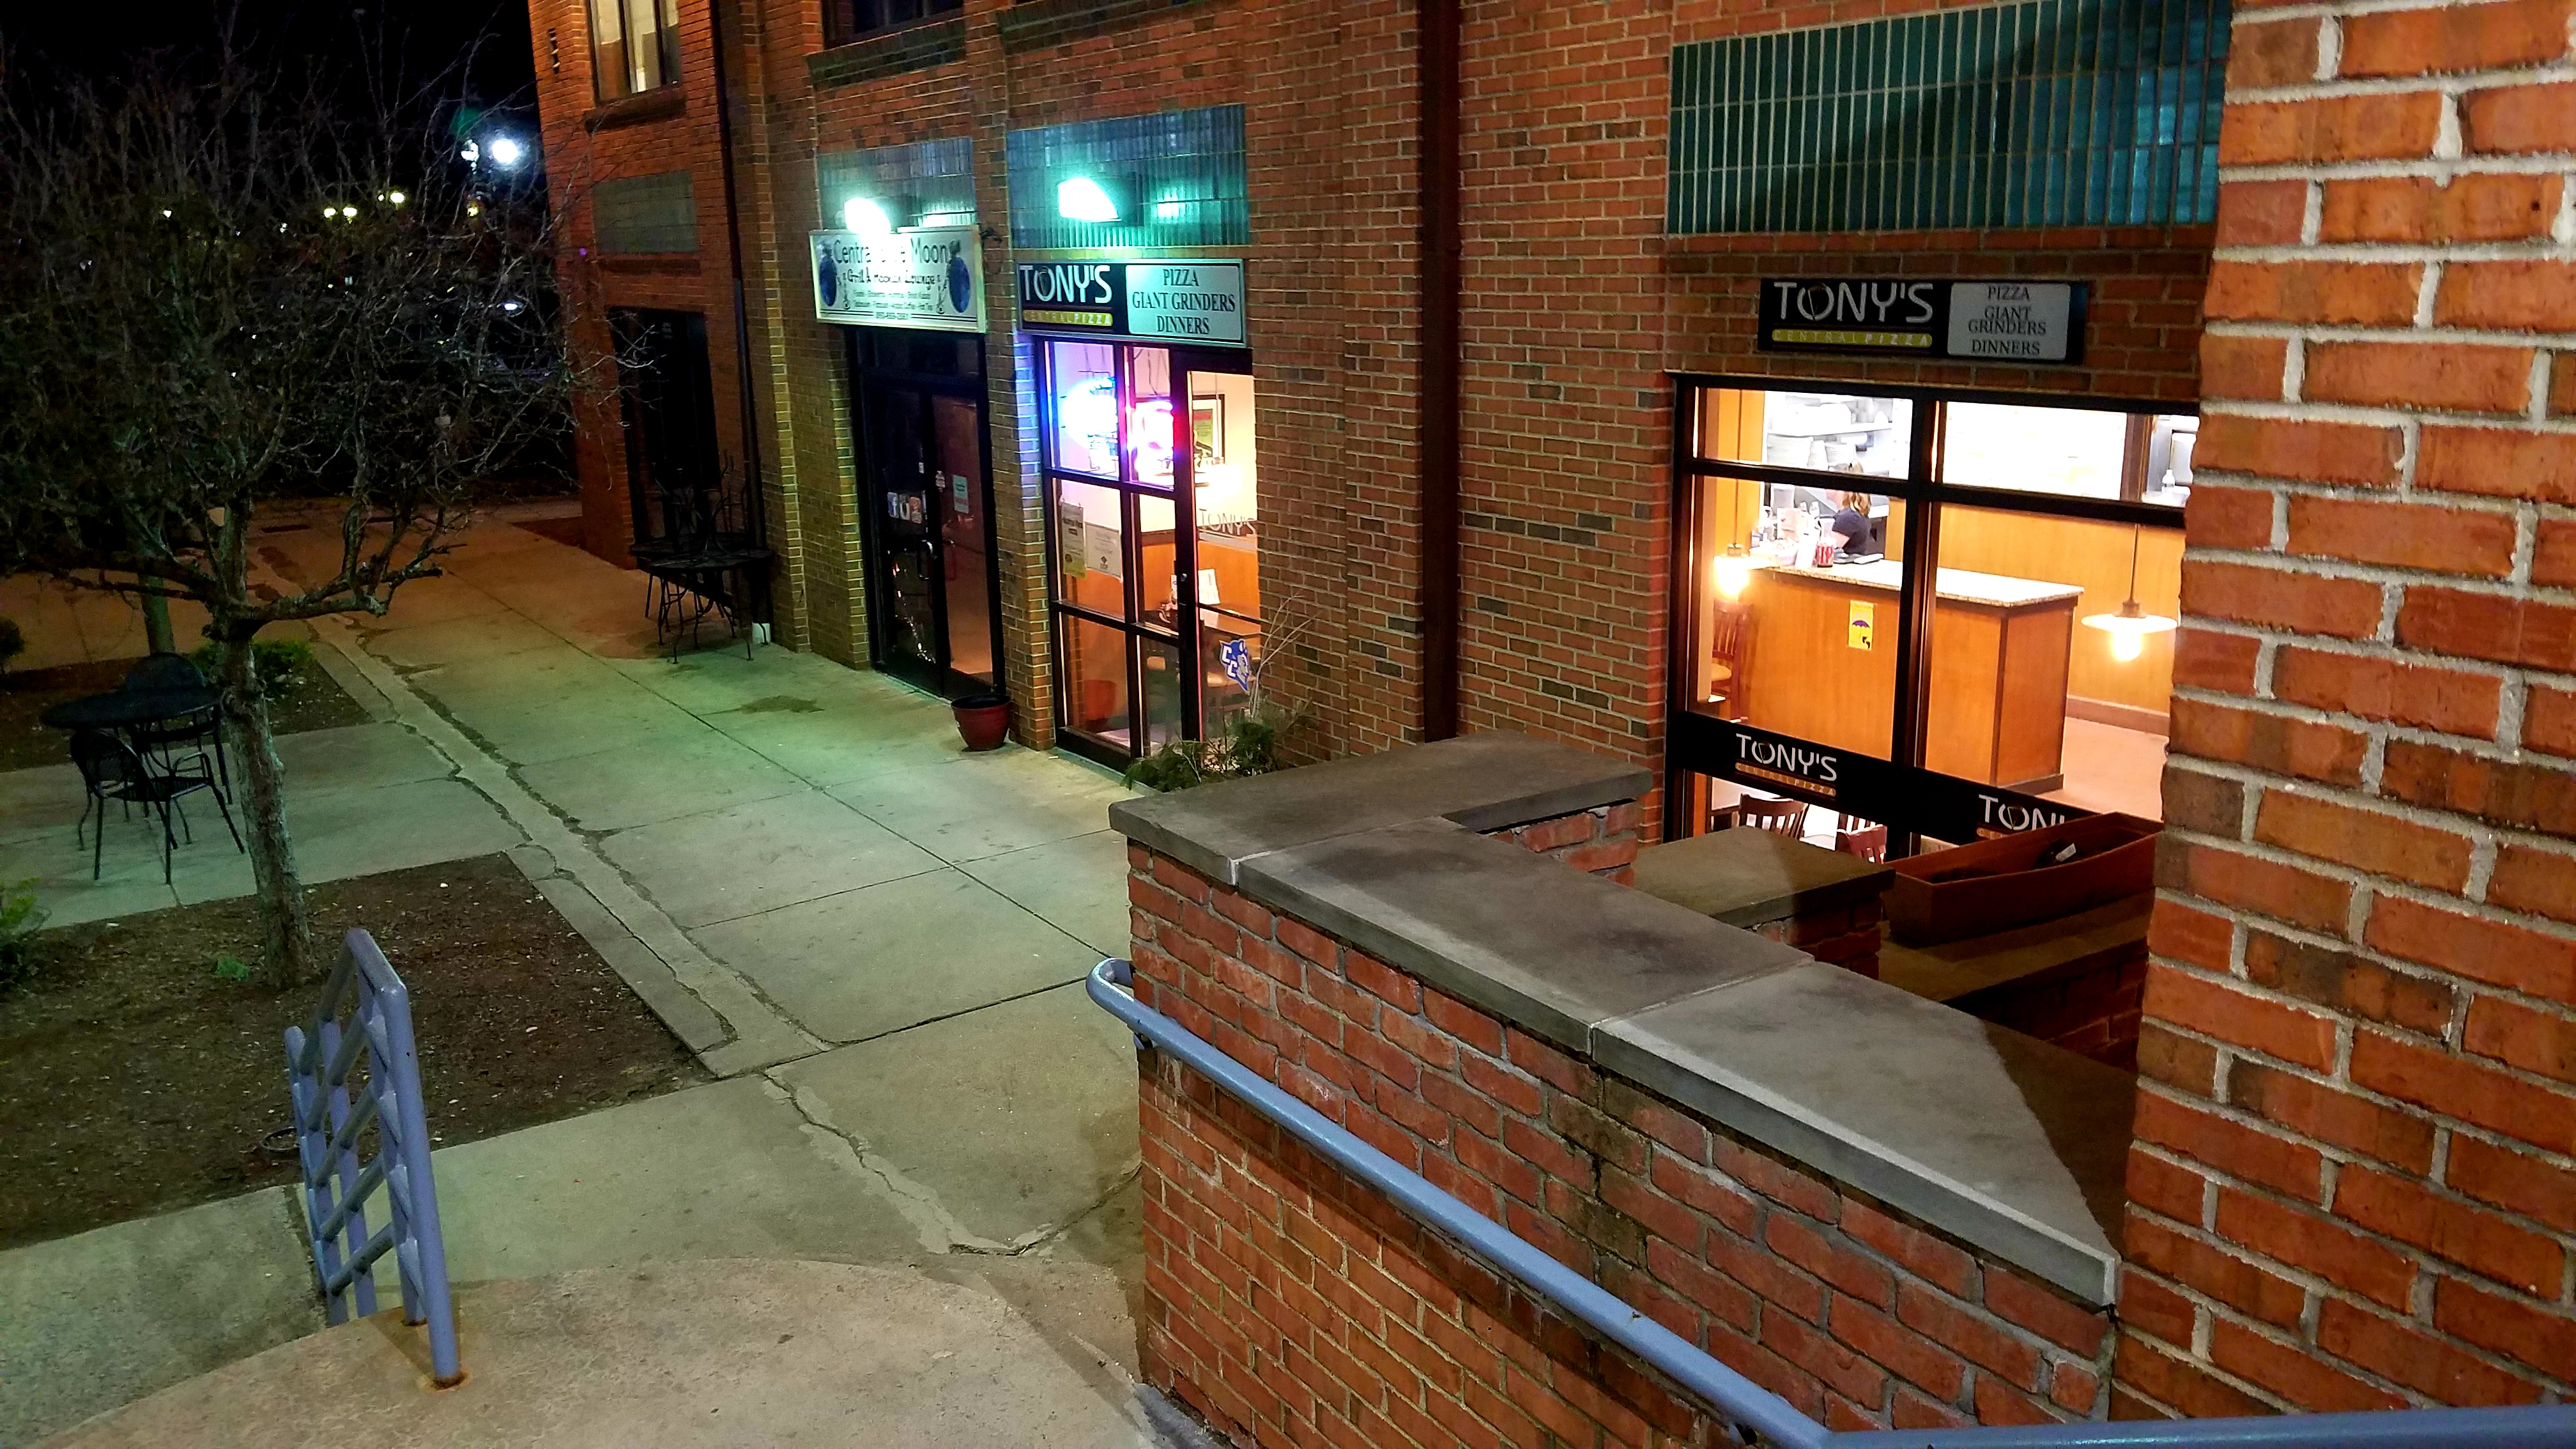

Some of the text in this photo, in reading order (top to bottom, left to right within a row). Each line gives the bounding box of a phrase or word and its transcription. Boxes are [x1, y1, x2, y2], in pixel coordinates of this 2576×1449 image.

[833, 240, 871, 264] Centra
[910, 238, 947, 264] Moon
[1020, 265, 1112, 303] TONY'S
[1163, 268, 1199, 286] PIZZA
[1132, 291, 1236, 312] GIANT GRINDERS
[1774, 282, 1933, 323] TONY'S
[1988, 285, 2030, 301] PIZZA
[1984, 305, 2032, 321] GIANT
[1156, 316, 1210, 334] DINNERS
[1968, 319, 2046, 335] GRINDERS
[1972, 339, 2040, 355] DINNERS
[1199, 509, 1256, 537] TONY'S
[1736, 733, 1837, 781] TONY'S
